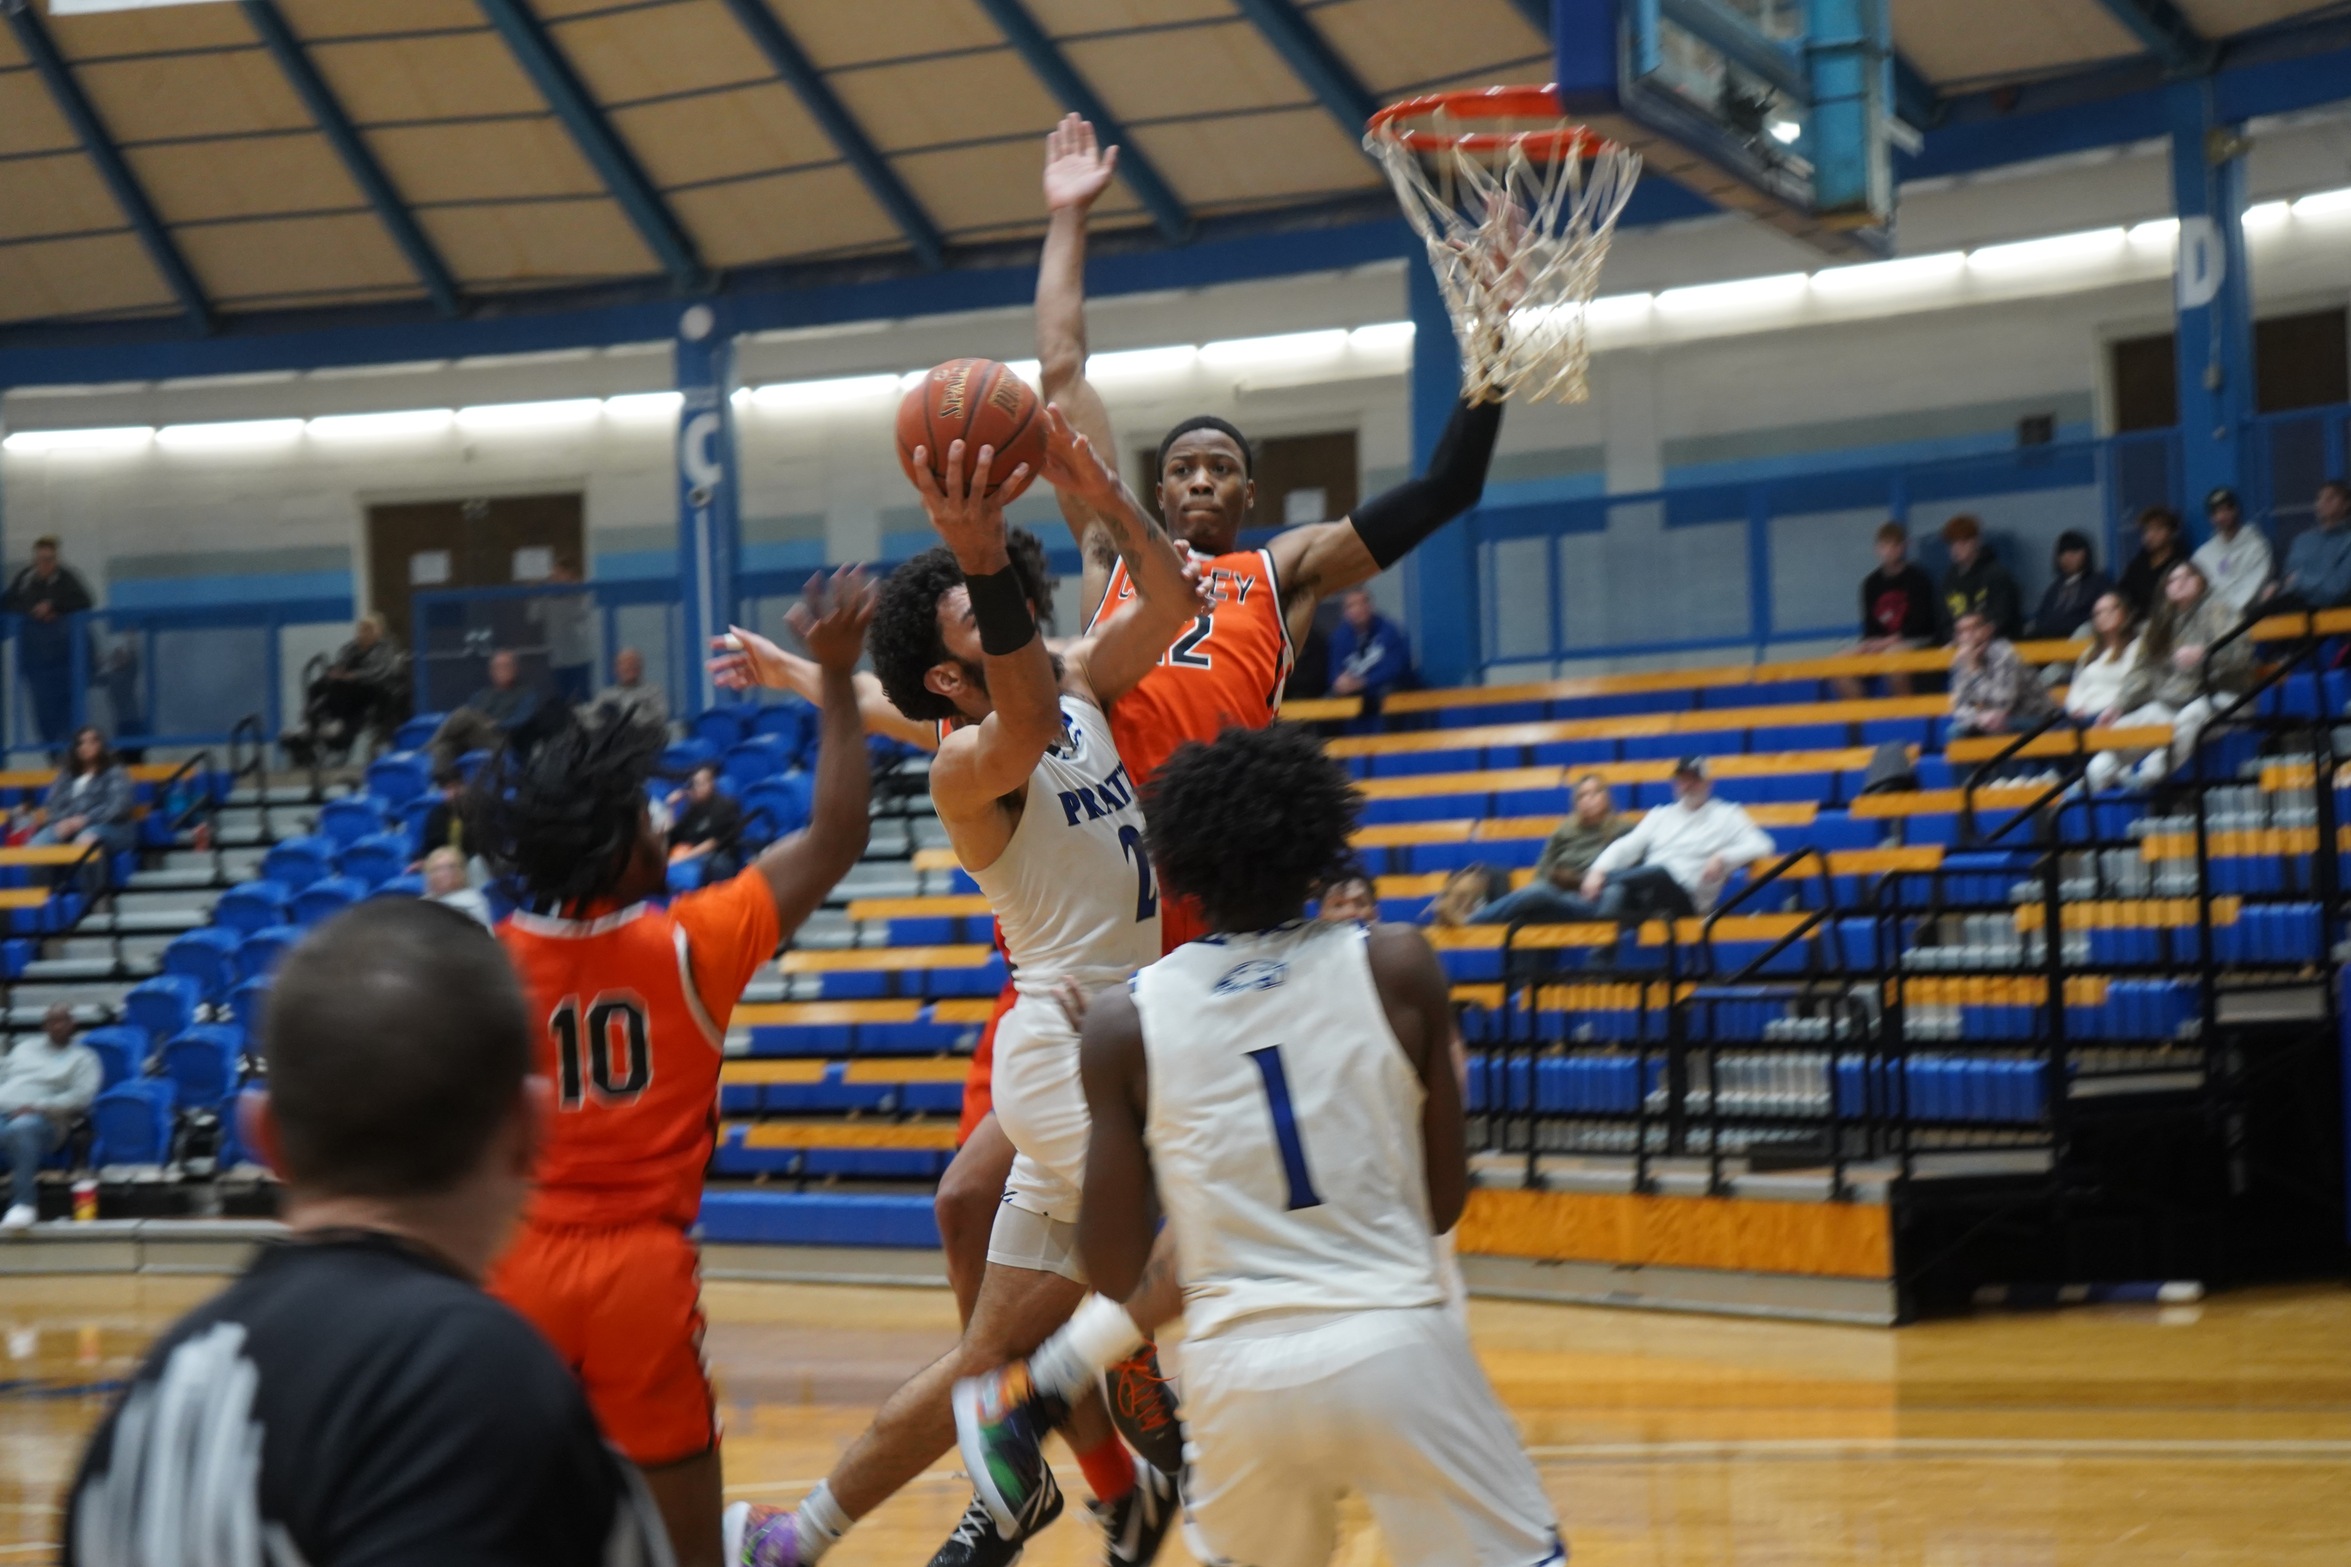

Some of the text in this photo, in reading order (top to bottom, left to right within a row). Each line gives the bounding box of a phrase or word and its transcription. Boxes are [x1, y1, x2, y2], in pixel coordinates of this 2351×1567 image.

[2178, 215, 2226, 310] D
[683, 412, 723, 487] C
[1156, 613, 1215, 670] 2
[548, 986, 655, 1113] 10
[1241, 1043, 1328, 1212] 1
